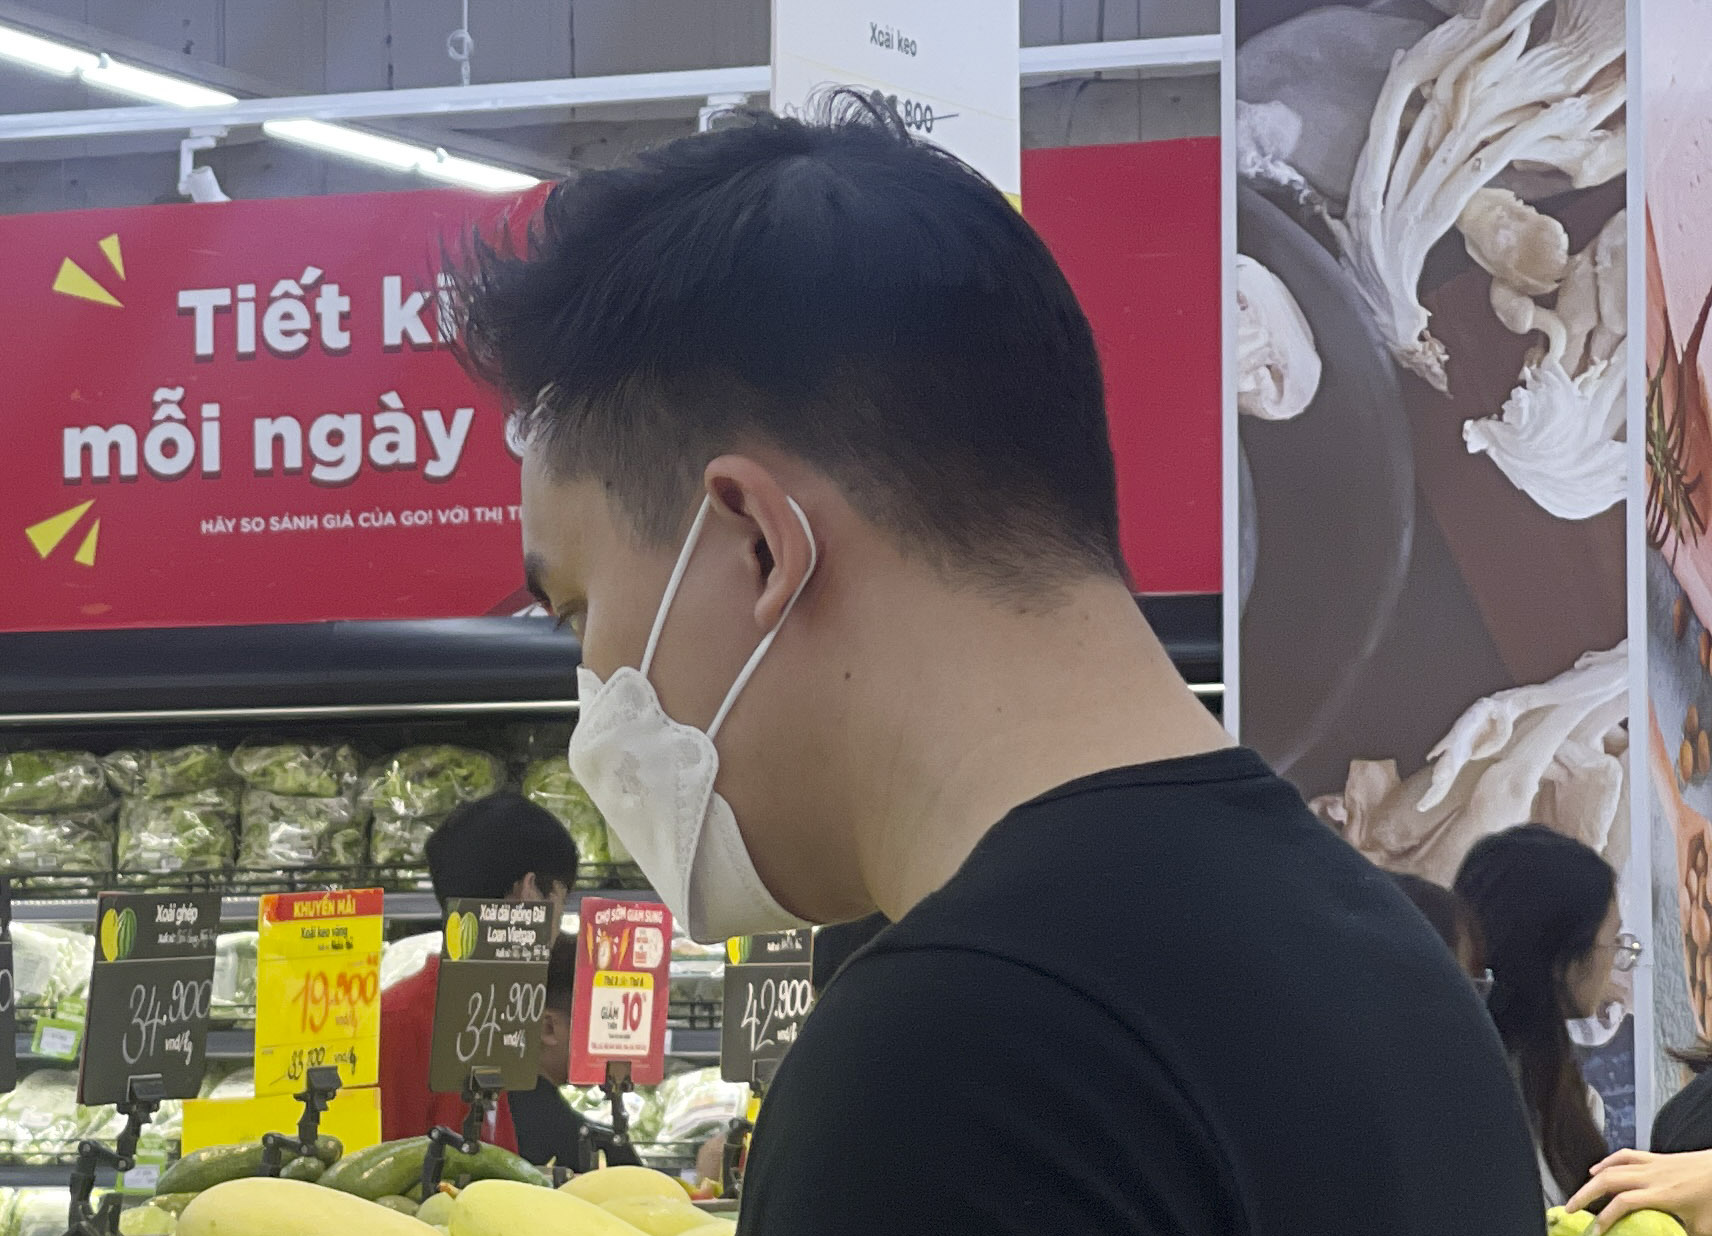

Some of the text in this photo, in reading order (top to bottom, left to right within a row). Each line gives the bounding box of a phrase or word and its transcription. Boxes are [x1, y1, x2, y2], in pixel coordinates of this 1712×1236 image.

[897, 30, 918, 57] keo
[178, 266, 351, 361] Tiết
[63, 386, 221, 485] mỗi
[254, 390, 474, 485] ngày
[200, 516, 235, 534] HÃY
[241, 518, 265, 532] SO
[270, 511, 318, 531] SÁNH
[323, 510, 354, 529] GIÁ
[358, 507, 396, 528] CỦA
[400, 509, 433, 526] GO!
[437, 505, 469, 524] VỚI
[474, 506, 503, 525] THỊ
[155, 902, 198, 925] Xoài ghép
[487, 926, 506, 942] Loan
[122, 980, 212, 1064] 34.900
[456, 982, 546, 1062] 34.900
[741, 978, 814, 1051] 42.900
